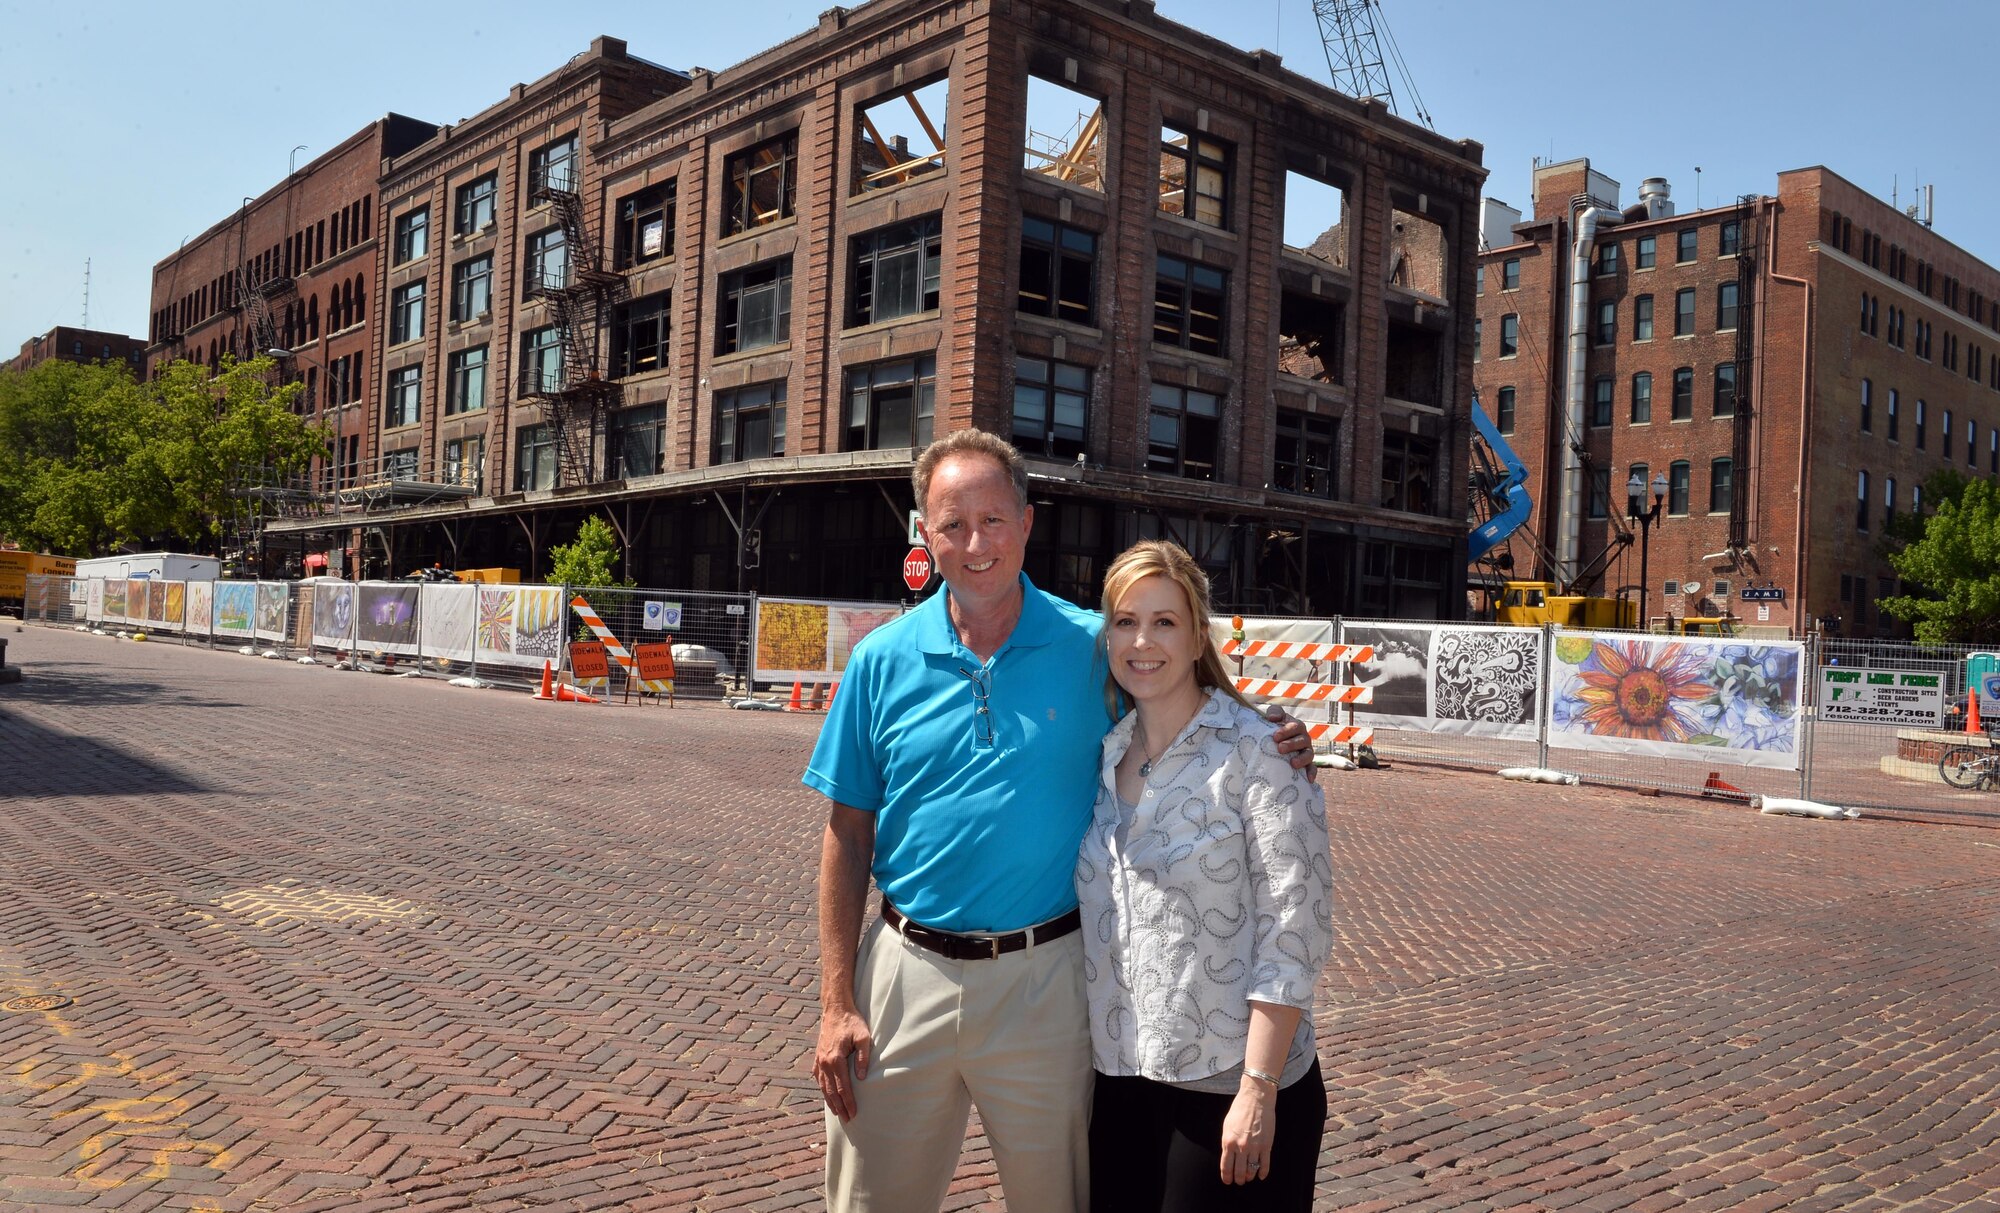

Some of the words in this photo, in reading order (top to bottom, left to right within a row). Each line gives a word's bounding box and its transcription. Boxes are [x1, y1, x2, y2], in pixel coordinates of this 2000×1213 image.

[905, 561, 929, 577] STOP
[571, 647, 603, 656] SIDEWALK
[638, 650, 670, 659] SIDEWALK
[577, 663, 604, 672] CLOSED
[643, 664, 670, 673] CLOSED
[1825, 670, 1862, 684] FIRST
[1866, 672, 1895, 686] LINE
[1899, 674, 1939, 688] FENCE
[1877, 687, 1918, 696] CONSTRUCTION
[1920, 689, 1938, 697] SITES
[1825, 705, 1936, 718] 712-328-7368
[1825, 713, 1935, 725] resourcerental.com
